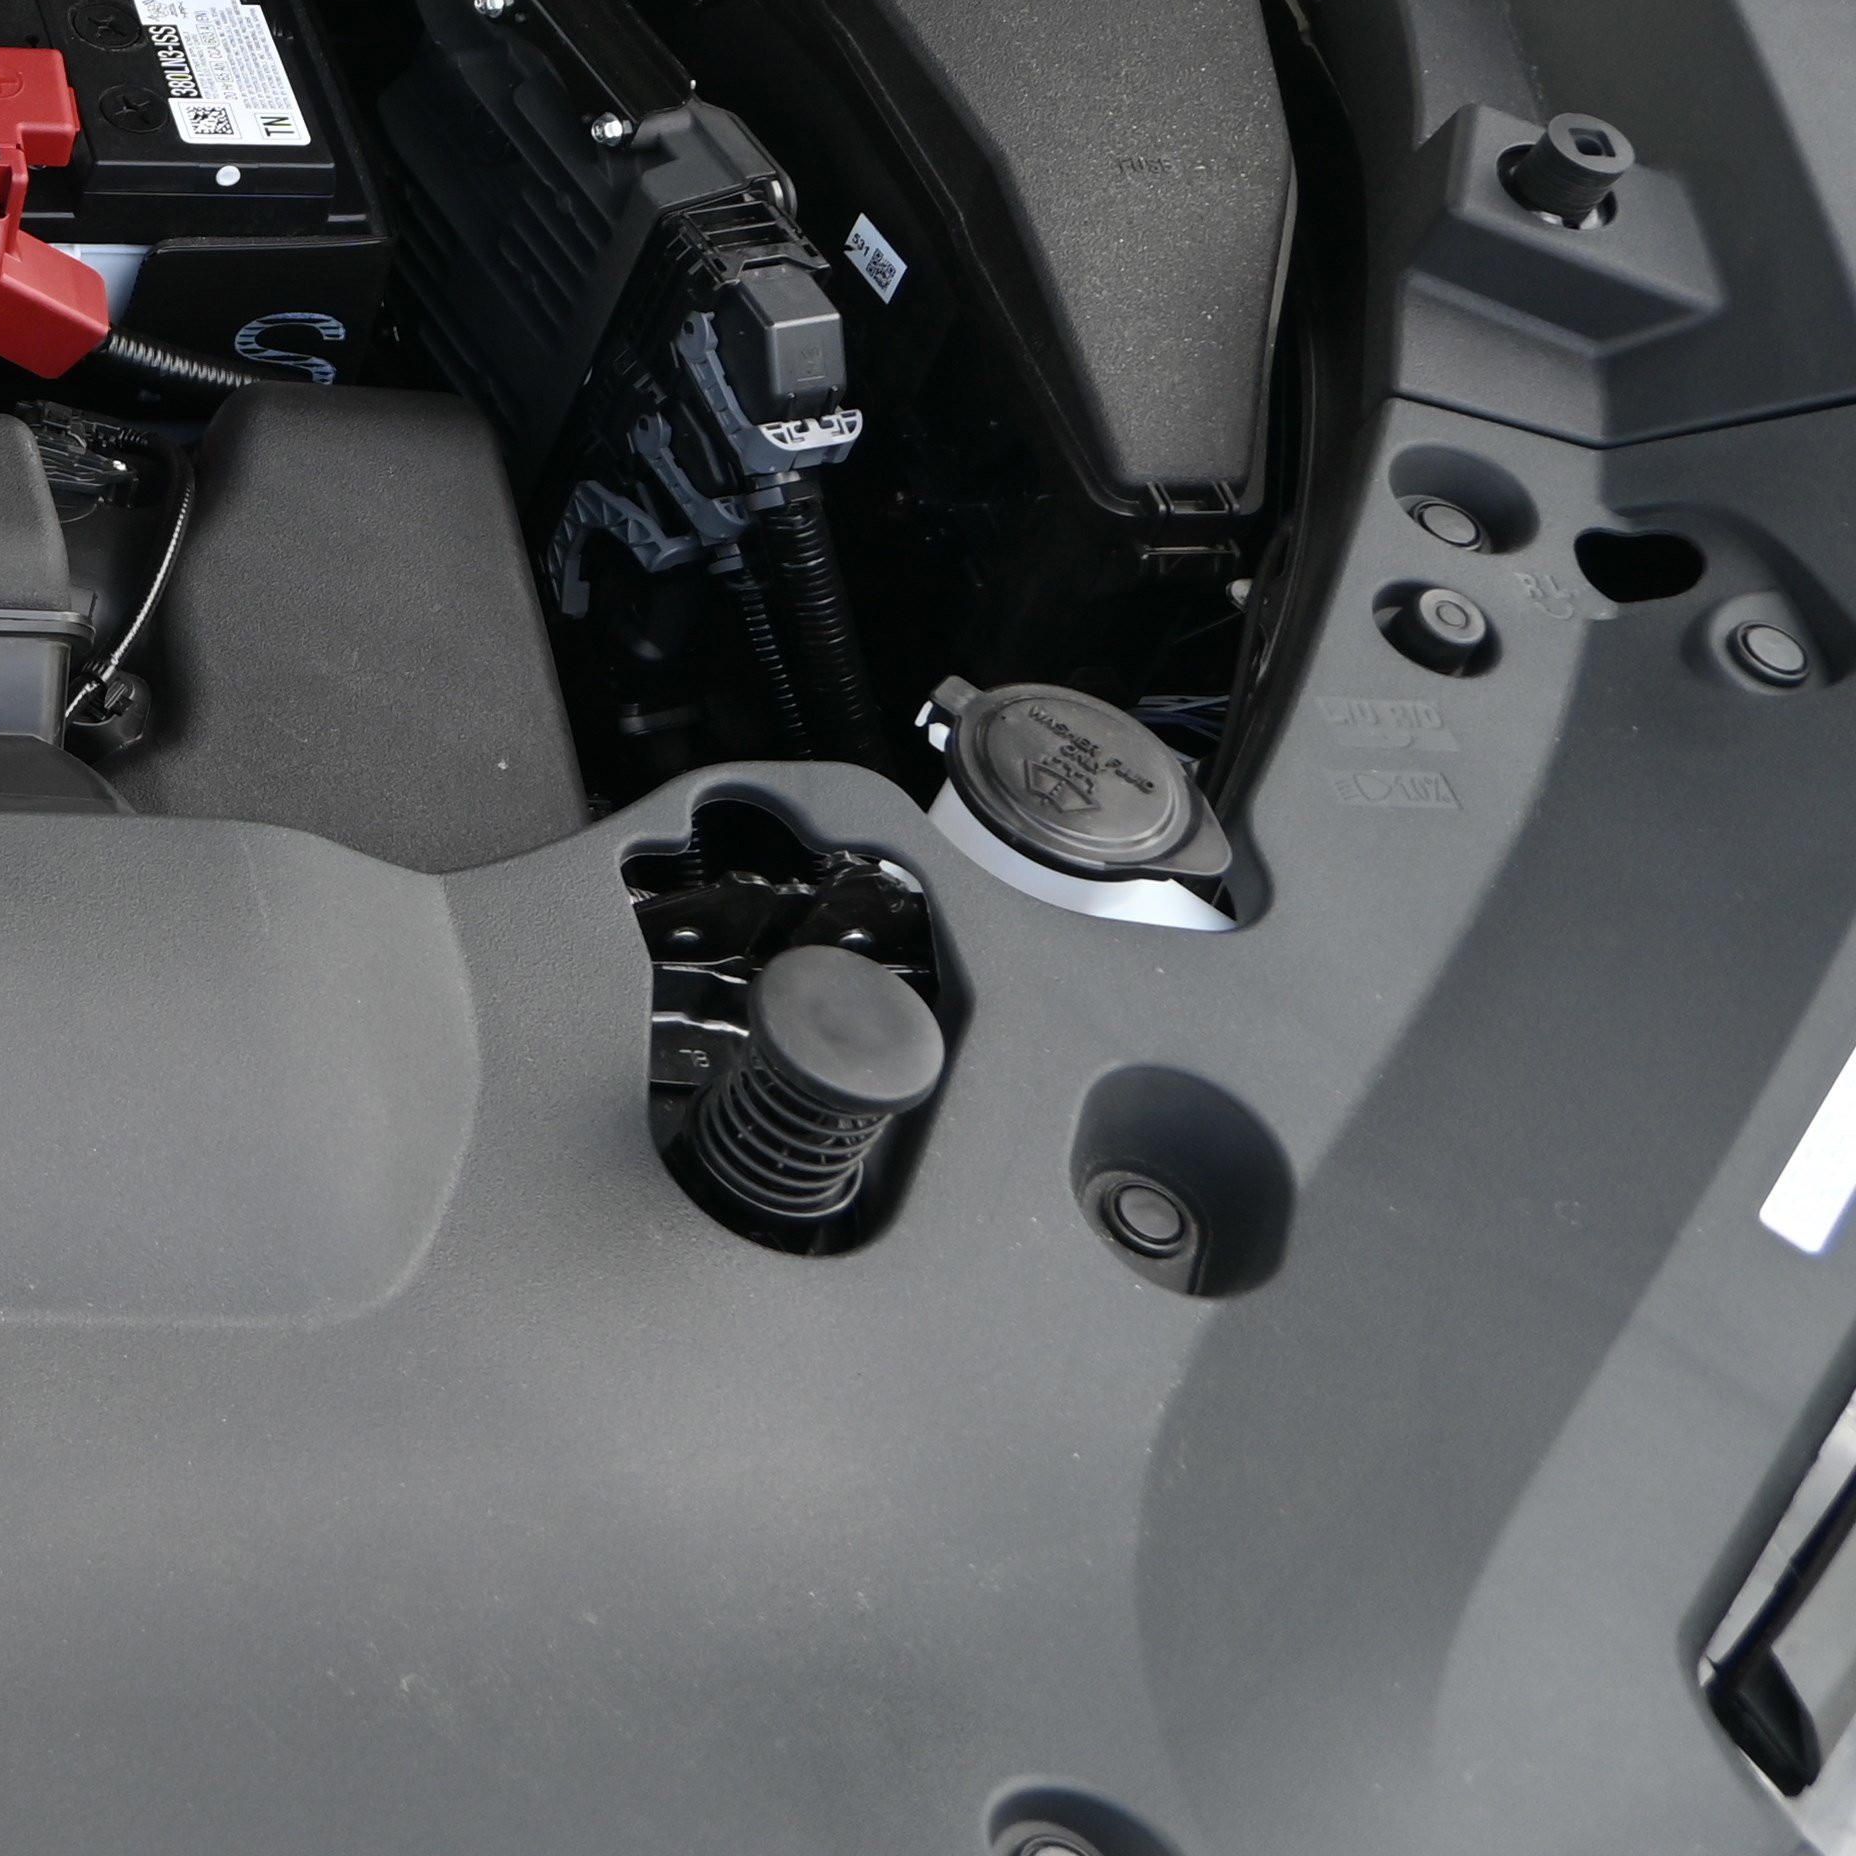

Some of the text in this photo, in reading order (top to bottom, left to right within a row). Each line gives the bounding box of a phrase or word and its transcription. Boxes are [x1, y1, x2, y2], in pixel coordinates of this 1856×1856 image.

[146, 26, 199, 96] 380LN3-ISS
[260, 116, 295, 136] TN
[852, 233, 870, 257] 531
[1028, 705, 1156, 794] WASHER FLUID
